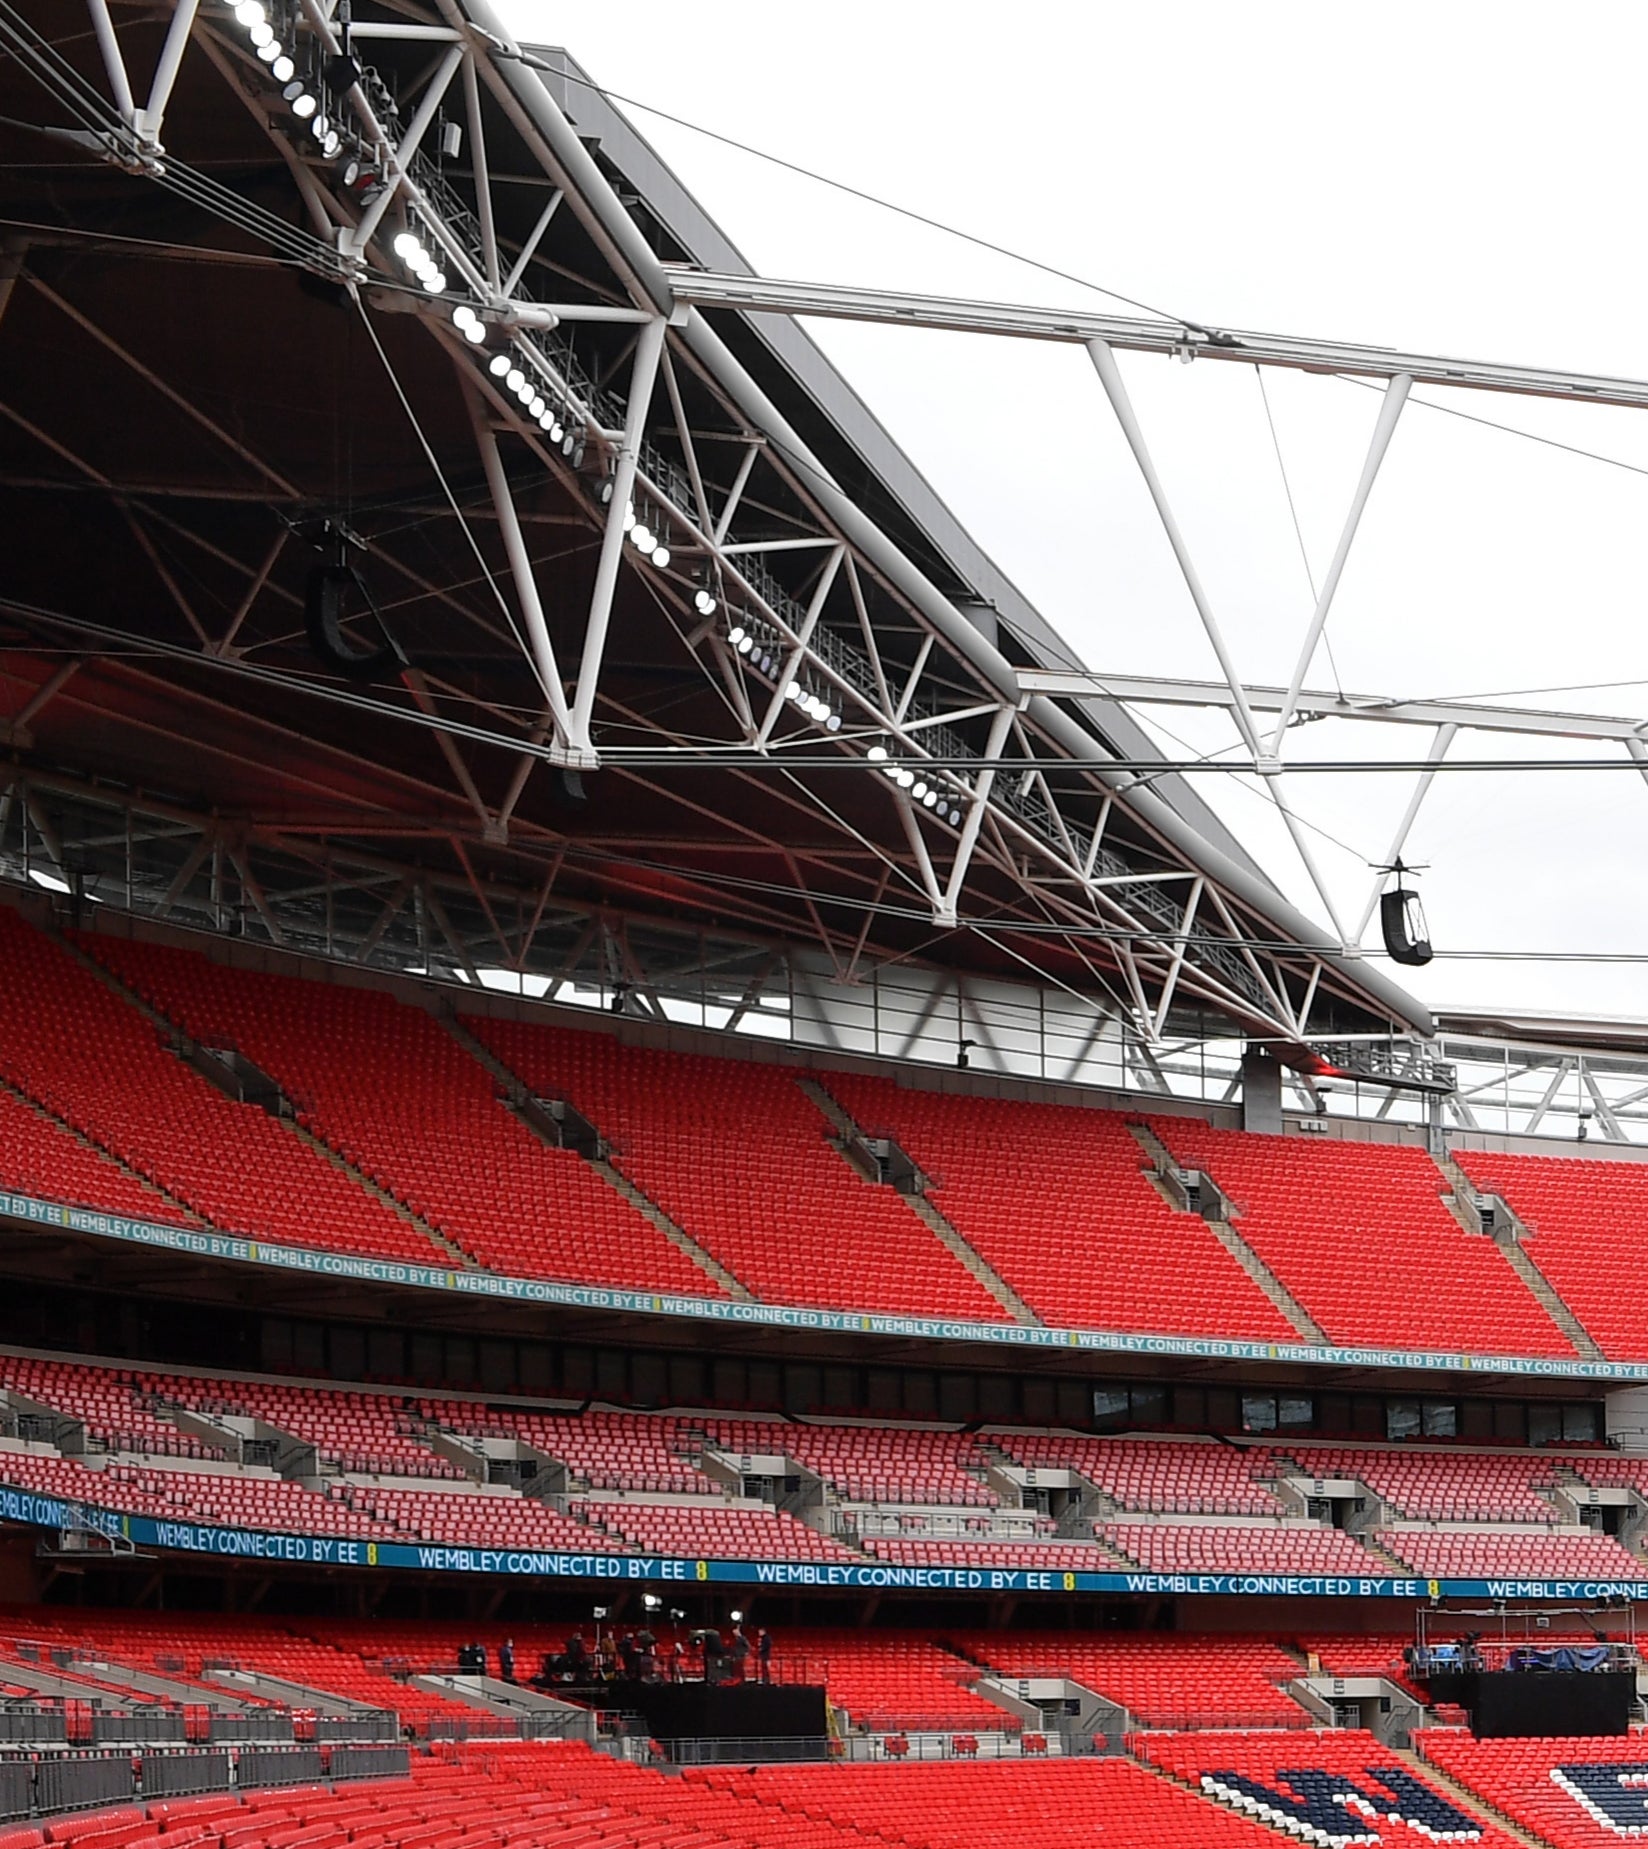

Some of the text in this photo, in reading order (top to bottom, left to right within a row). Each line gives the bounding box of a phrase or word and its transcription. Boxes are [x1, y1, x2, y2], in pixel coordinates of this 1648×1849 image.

[68, 1209, 248, 1258] WEMBLEY CONNECTED BY EE
[256, 1244, 444, 1286] WEMBLEY CONNECTED BY EE
[455, 1274, 650, 1310] WEMBLEY CONNECTED BY EE
[660, 1298, 860, 1329] WEMBLEY CONNECTED BY EE
[870, 1317, 1067, 1344] WEMBLEY CONNECTED BY EE
[1078, 1333, 1266, 1357] WEMBLEY CONNECTED BY EE
[1276, 1346, 1460, 1368] WEMBLEY CONNECTED BY EE
[1470, 1358, 1648, 1379] WEMBLEY CONNECTED BY EE
[0, 1489, 33, 1523] EMBLEY
[155, 1521, 358, 1564] WEMBLEY CONNECTED BY EE
[419, 1548, 684, 1580] WEMBLEY CONNECTED BY EE
[755, 1563, 1050, 1589] WEMBLEY CONNECTED BY EE
[1125, 1574, 1416, 1596] WEMBLEY CONNECTED BY EE
[1486, 1581, 1578, 1598] WEMBLEY
